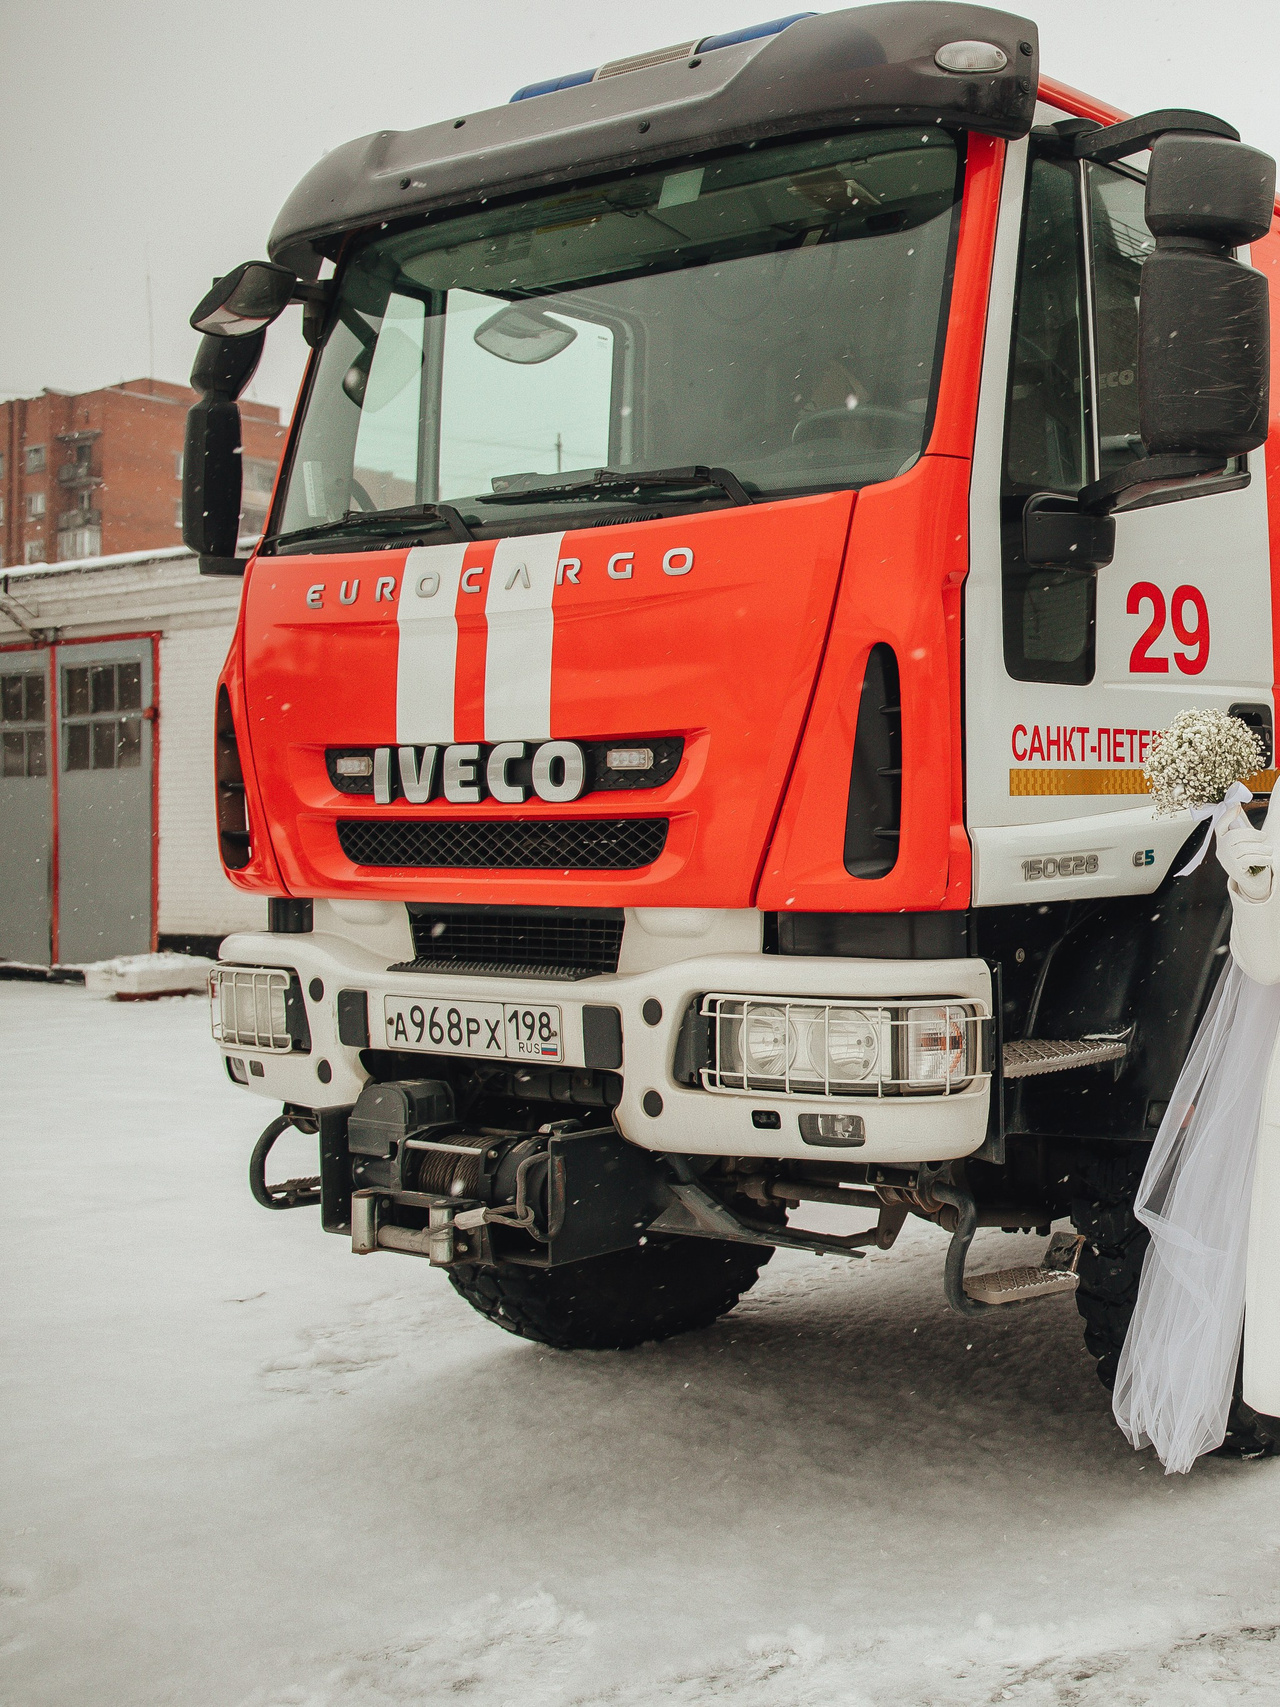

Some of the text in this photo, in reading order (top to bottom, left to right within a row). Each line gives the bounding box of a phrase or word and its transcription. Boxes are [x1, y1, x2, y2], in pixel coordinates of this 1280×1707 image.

[306, 546, 694, 610] EUROCARGO
[1126, 581, 1210, 676] 29
[1011, 723, 1169, 763] САНКТ-ПЕТЕ
[374, 740, 587, 805] IVECO
[1021, 849, 1155, 882] 150E28 E5
[508, 1009, 552, 1042] 198
[518, 1041, 540, 1054] RUS
